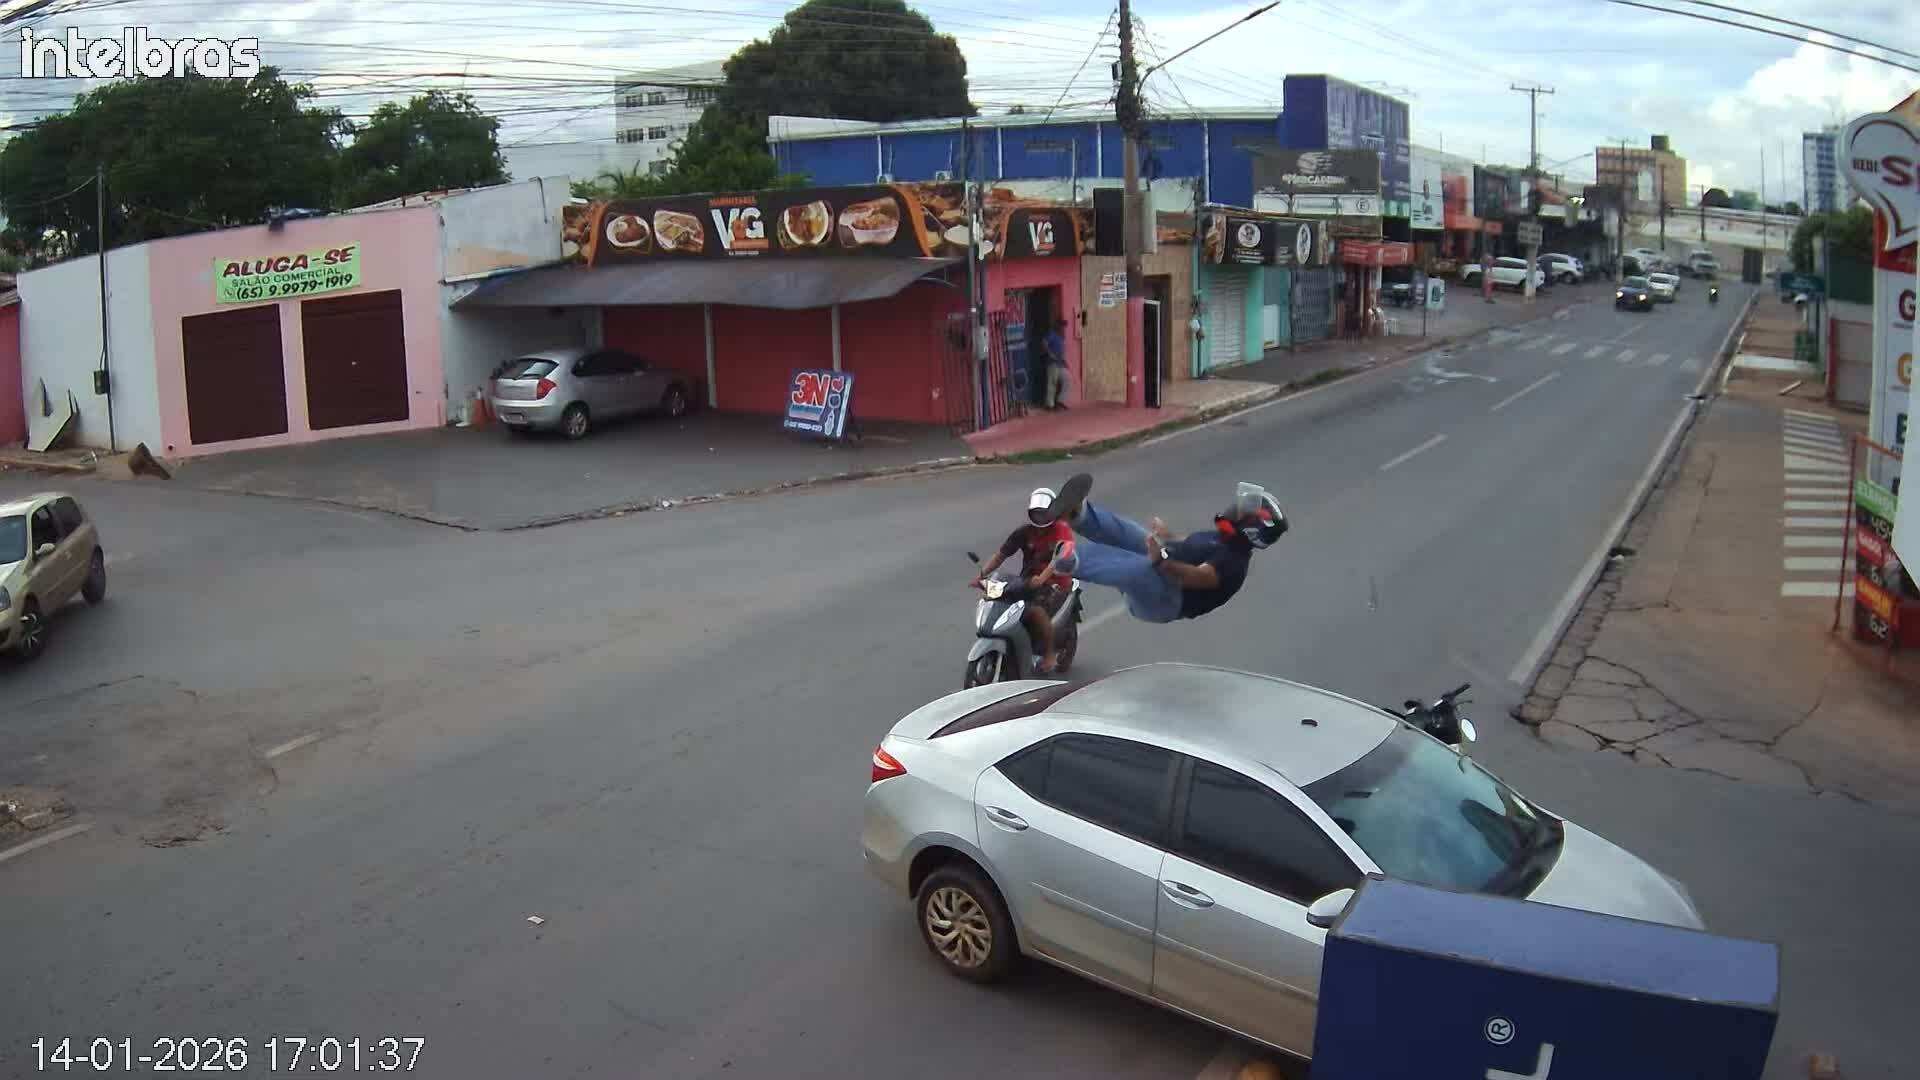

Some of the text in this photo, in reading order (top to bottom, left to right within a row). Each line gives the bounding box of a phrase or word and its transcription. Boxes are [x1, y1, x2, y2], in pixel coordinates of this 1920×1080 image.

[223, 246, 356, 279] ALUGA-SE
[231, 267, 341, 288] SALÃO COMERCIAL
[236, 274, 353, 301] (65) 9.9979-1919
[791, 372, 832, 408] 3N
